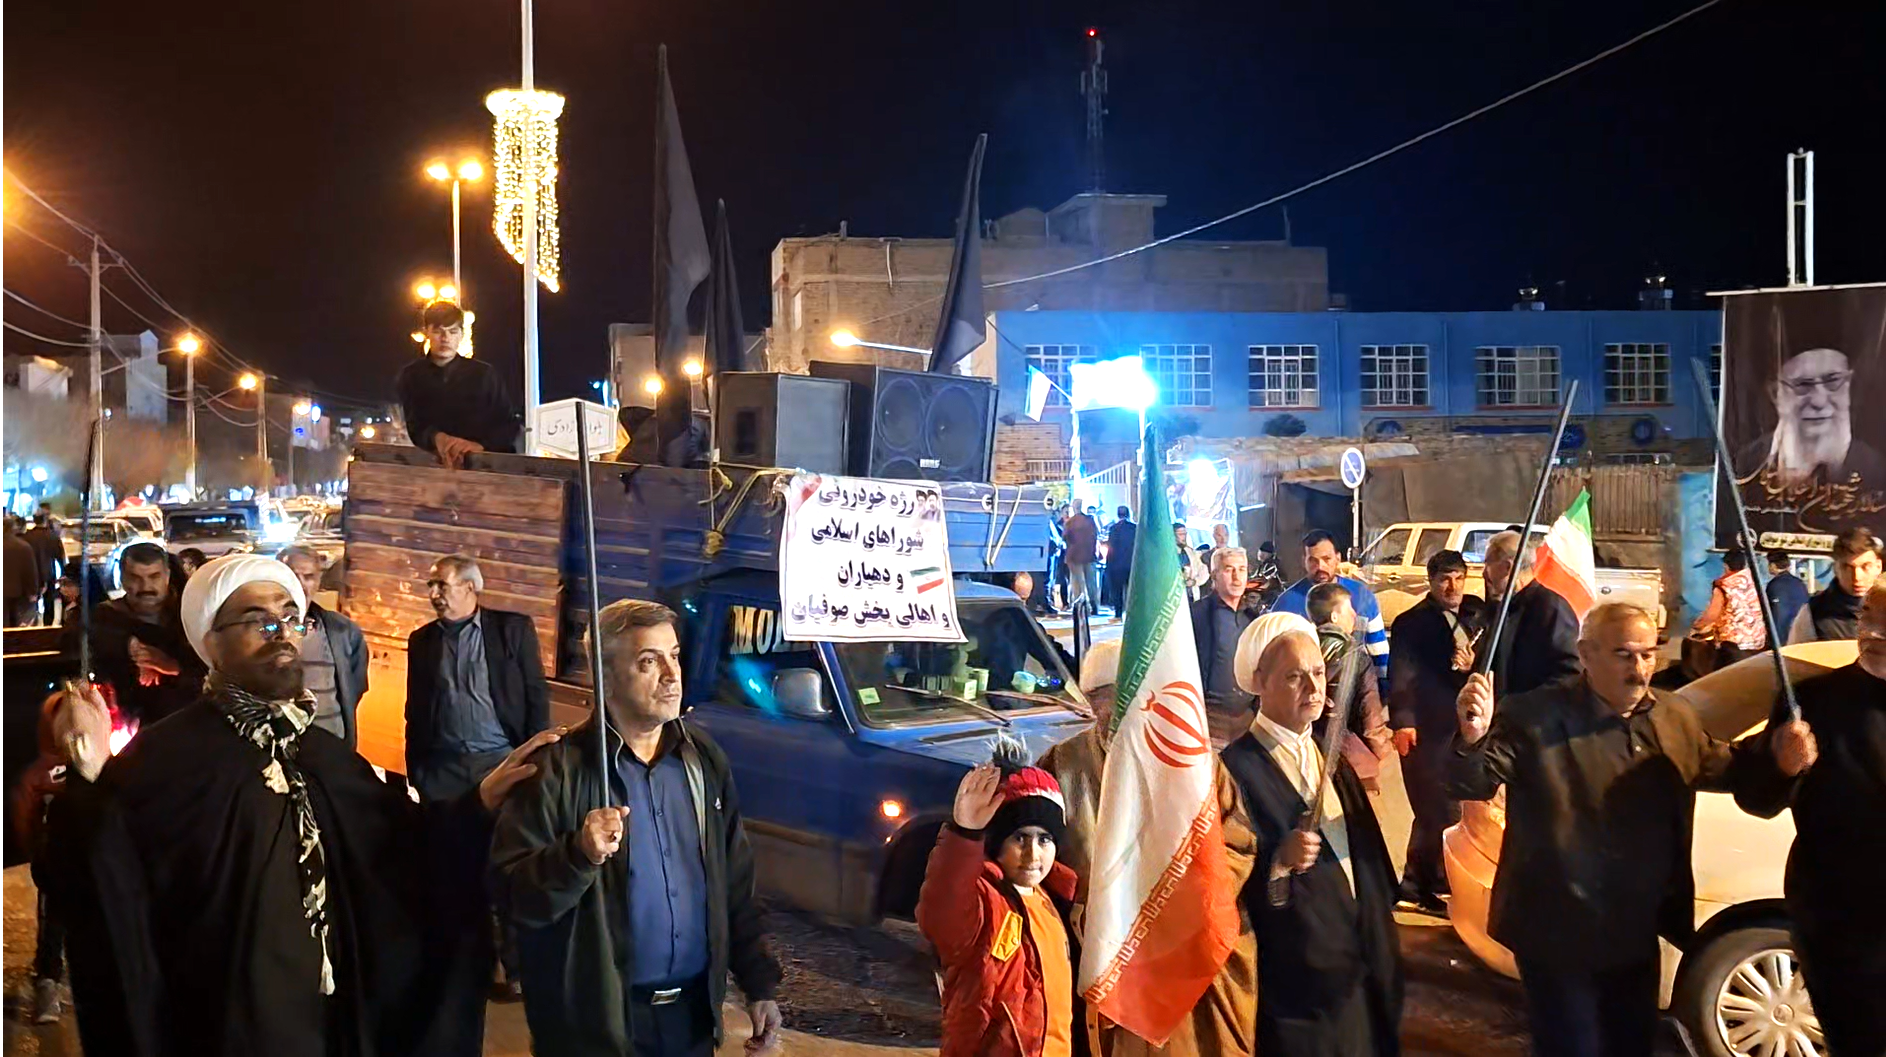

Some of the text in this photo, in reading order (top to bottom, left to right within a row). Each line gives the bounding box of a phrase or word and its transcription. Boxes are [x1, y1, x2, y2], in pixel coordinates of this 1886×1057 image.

[890, 490, 915, 515] رژه
[812, 517, 924, 554] شوراهای اسلامی
[838, 560, 904, 591] و دهیاران
[791, 594, 950, 629] و اهالی بخش صوفیان
